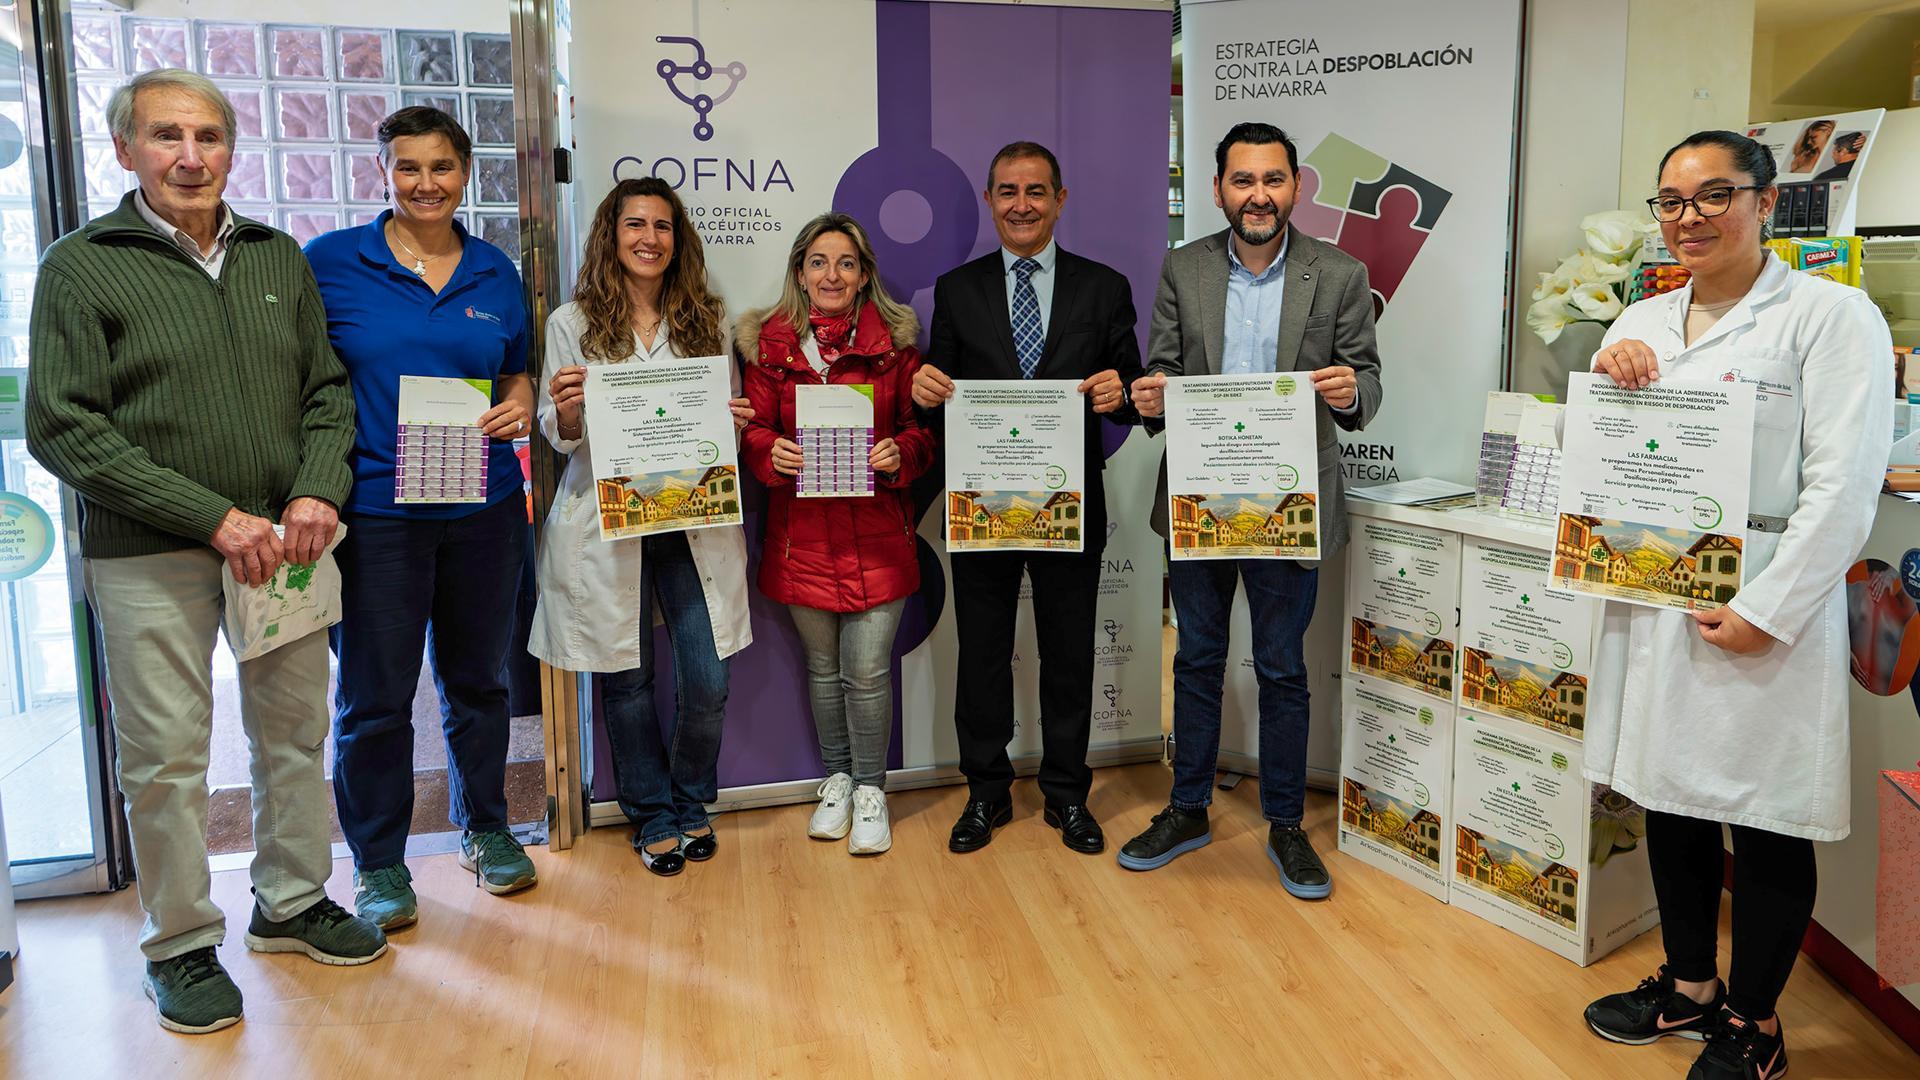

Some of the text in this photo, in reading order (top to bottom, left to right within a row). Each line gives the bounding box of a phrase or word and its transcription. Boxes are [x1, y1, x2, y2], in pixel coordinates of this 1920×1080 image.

[1216, 38, 1320, 60] ESTRATEGIA
[1215, 44, 1473, 80] CONTRA LA DESPOBLACIÓN
[1215, 80, 1327, 101] DE NAVARRA
[612, 156, 794, 192] COFNA
[712, 206, 772, 218] OFICIAL
[1806, 250, 1837, 262] CARMEX
[1672, 402, 1715, 411] DESPOBLACIÓN
[1641, 454, 1678, 462] FARMACIAS
[1608, 458, 1642, 467] preparamos
[1653, 463, 1695, 472] medicamentos
[1638, 468, 1682, 478] Personalizados
[1627, 482, 1650, 491] gratuito
[1673, 488, 1698, 497] paciente
[1094, 644, 1133, 655] COFNA
[1094, 708, 1132, 720] COFNA
